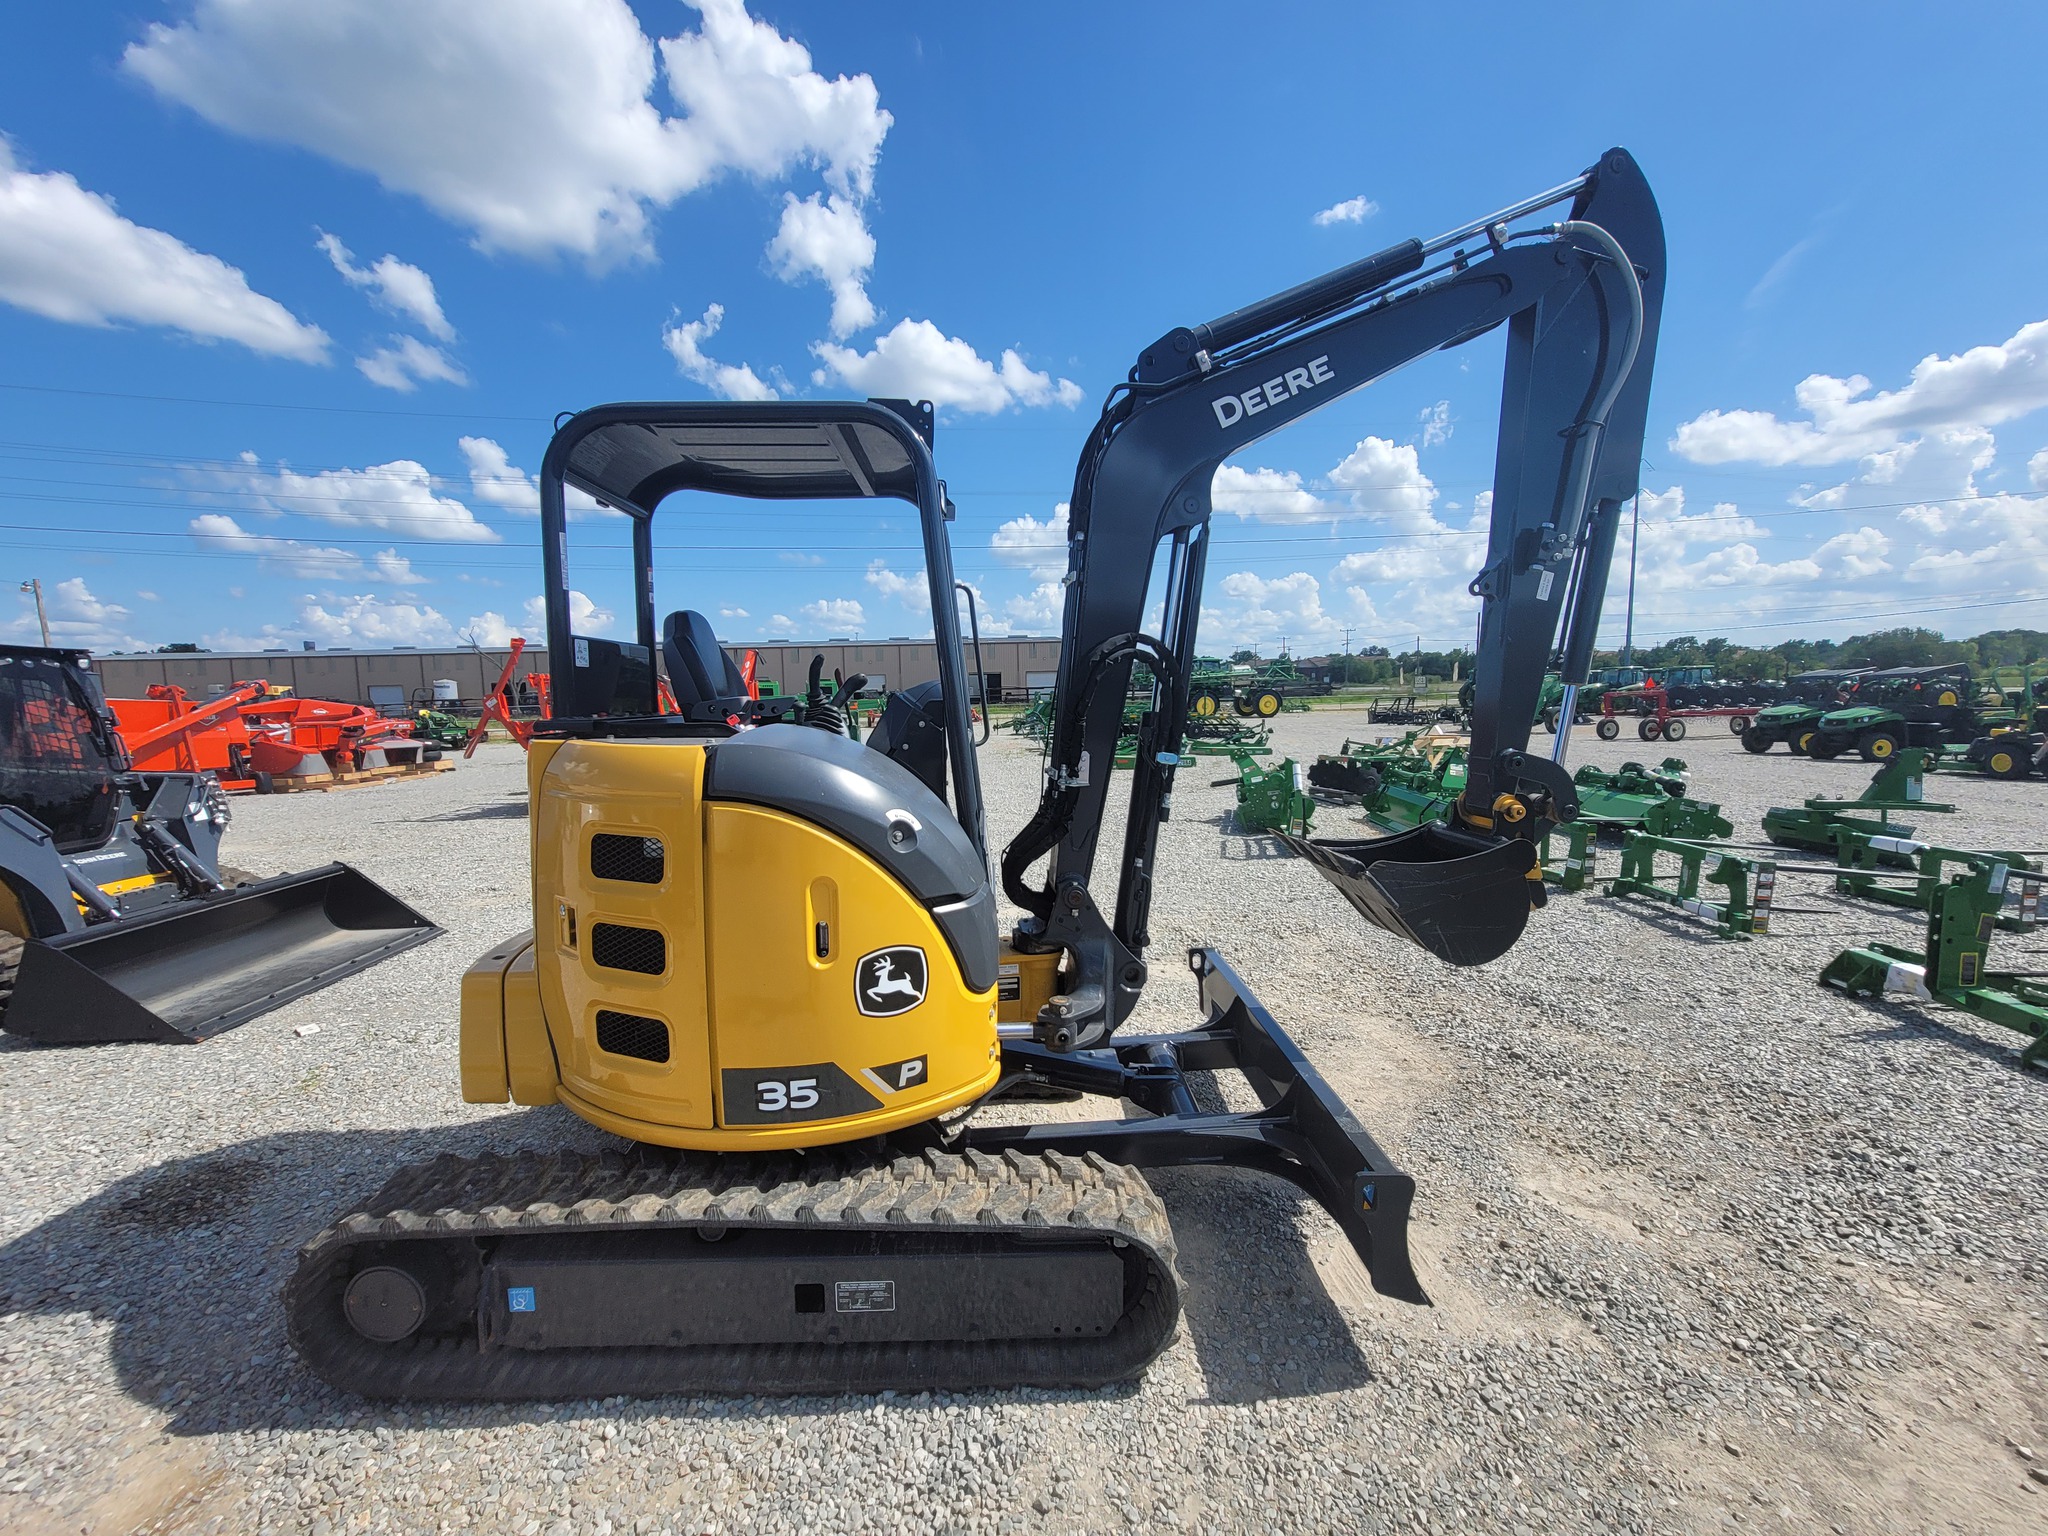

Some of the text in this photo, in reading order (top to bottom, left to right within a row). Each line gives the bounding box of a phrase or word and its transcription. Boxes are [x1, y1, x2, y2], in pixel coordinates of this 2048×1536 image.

[1211, 354, 1336, 430] DEERE
[73, 851, 127, 864] JOHN DEERE
[898, 1060, 923, 1087] P
[757, 1078, 819, 1112] 35
